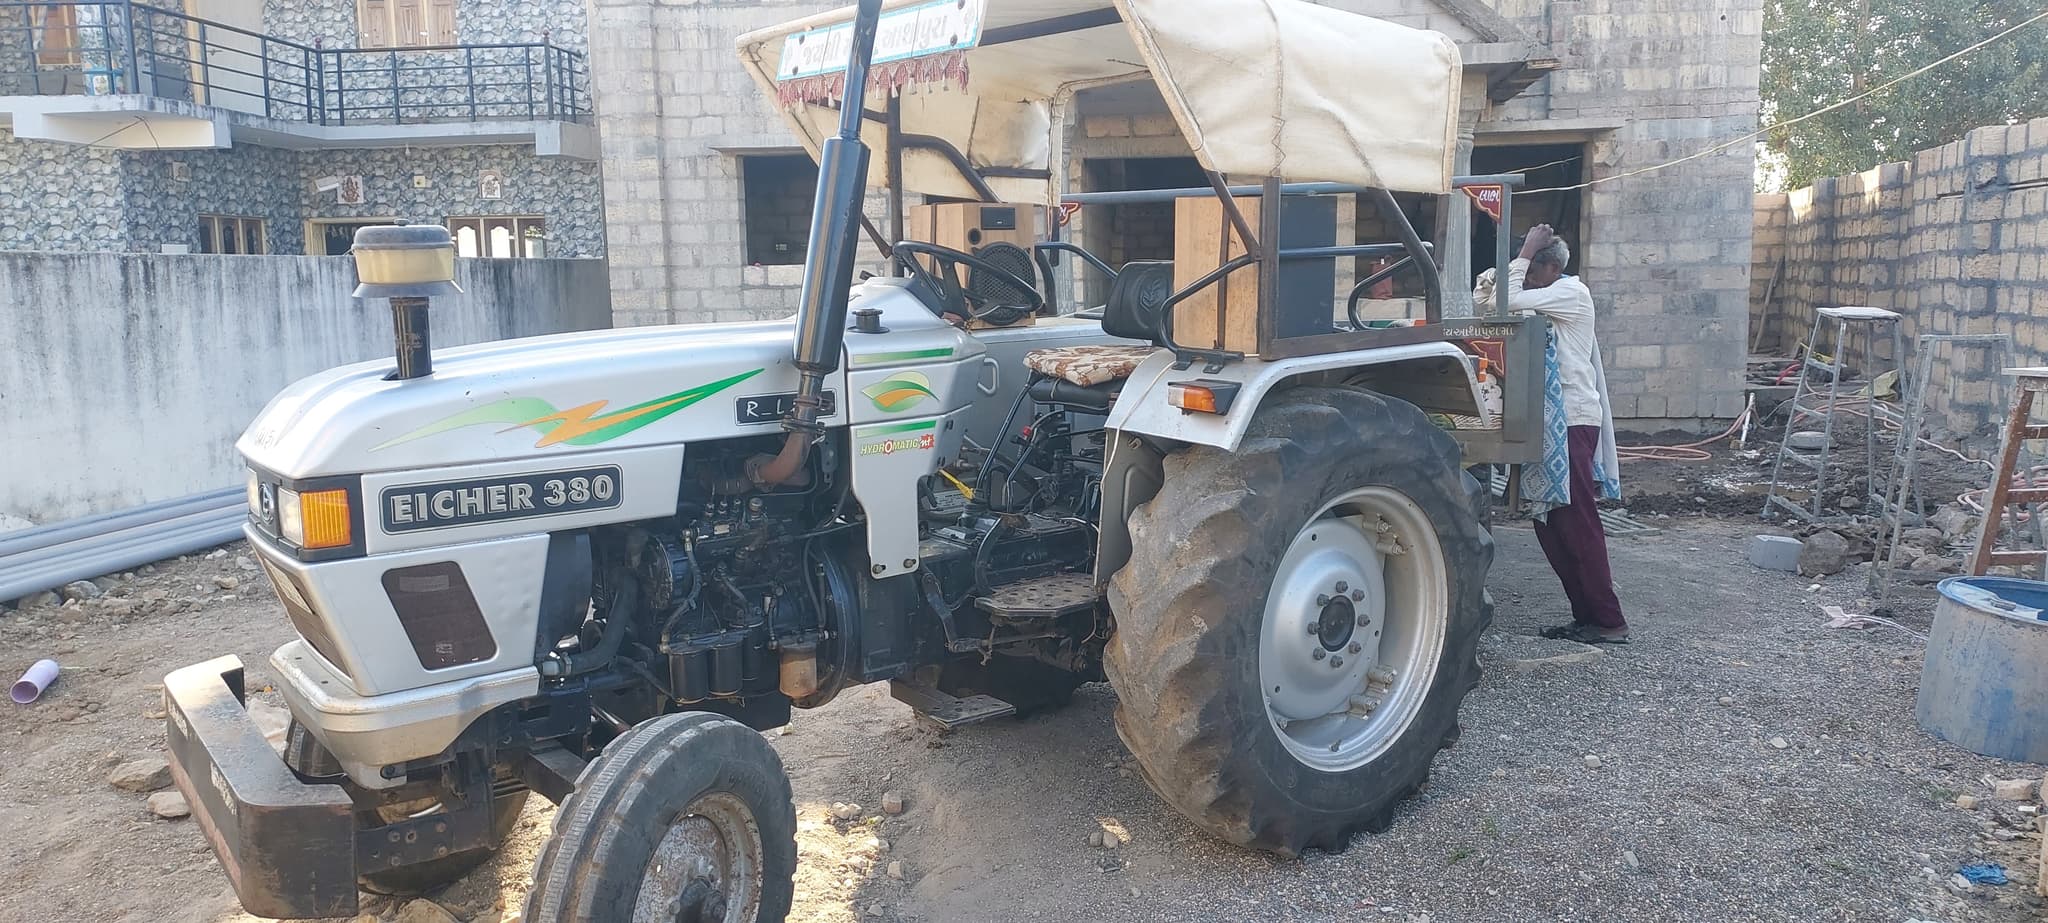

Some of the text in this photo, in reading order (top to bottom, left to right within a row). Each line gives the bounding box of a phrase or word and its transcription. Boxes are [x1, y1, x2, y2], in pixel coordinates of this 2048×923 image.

[860, 438, 918, 456] HYDROMATIC
[390, 474, 614, 525] EICHER 380
